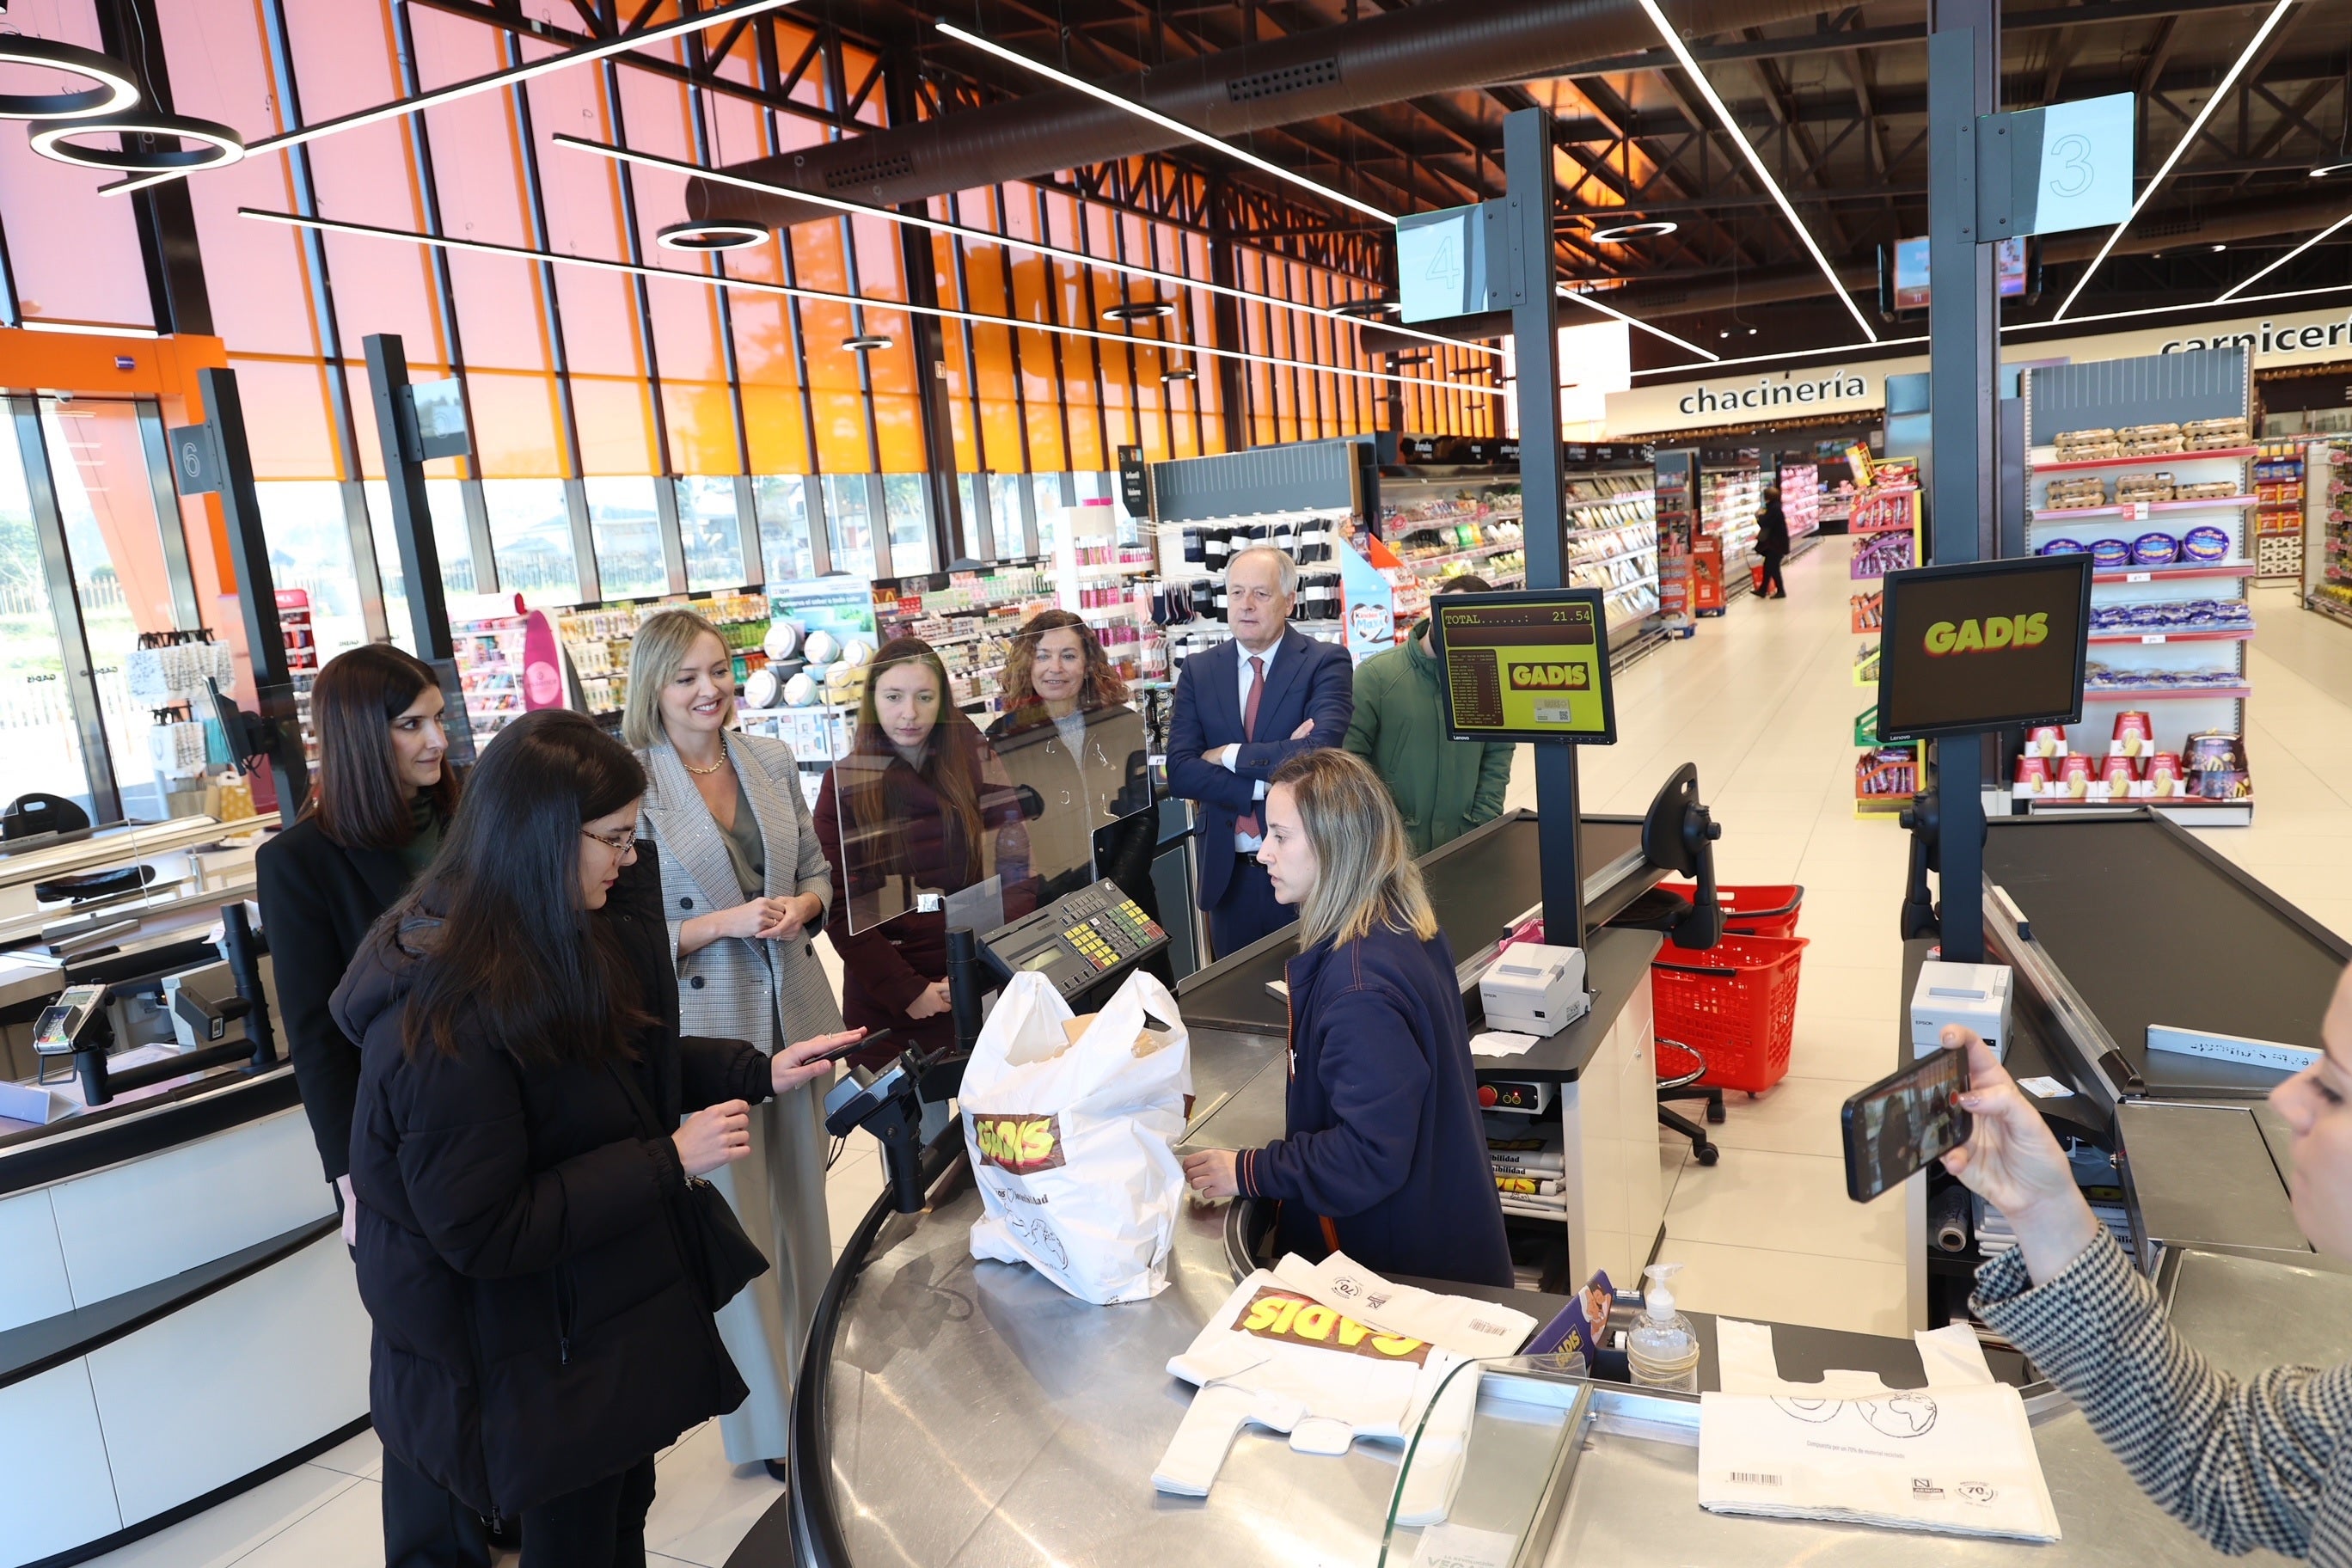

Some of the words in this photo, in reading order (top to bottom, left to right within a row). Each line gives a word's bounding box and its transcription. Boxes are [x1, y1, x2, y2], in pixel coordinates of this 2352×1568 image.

[2049, 133, 2094, 198] 3
[1425, 236, 1461, 290] 4
[1679, 370, 1865, 414] chacinería
[182, 442, 201, 478] 6
[1553, 610, 1590, 622] 21.54
[1923, 611, 2049, 658] GADIS
[1512, 665, 1588, 689] GADIS
